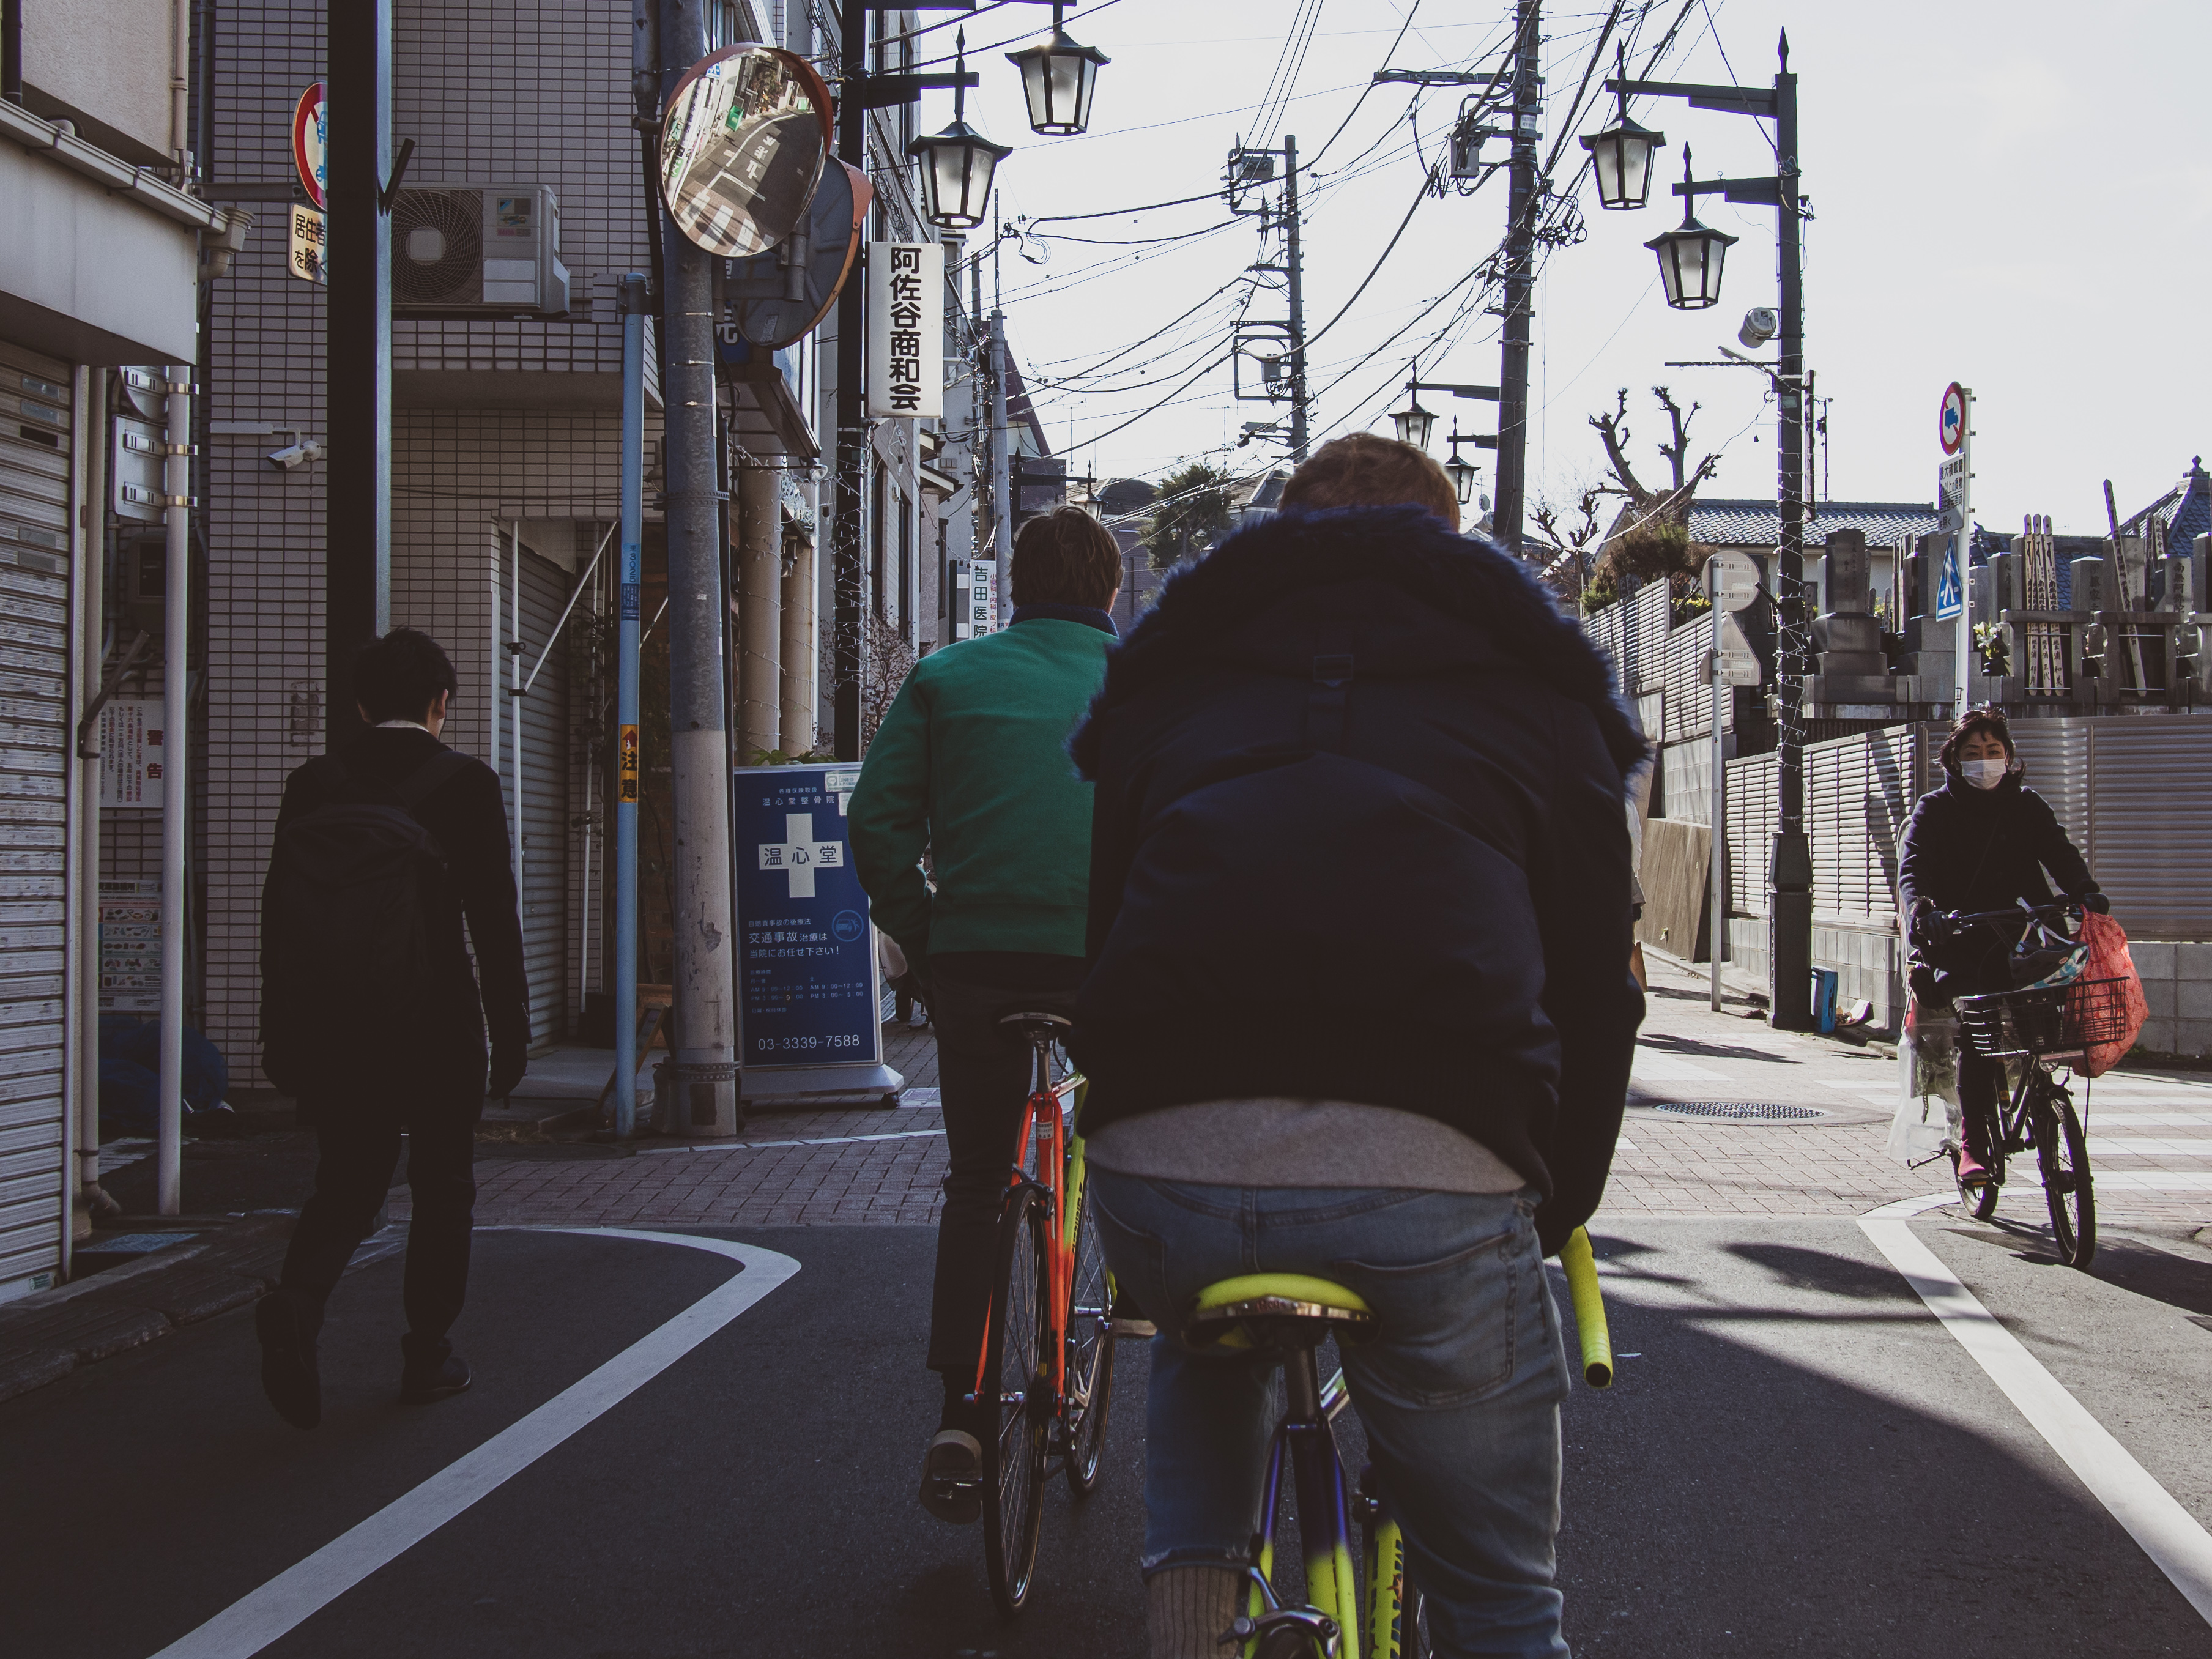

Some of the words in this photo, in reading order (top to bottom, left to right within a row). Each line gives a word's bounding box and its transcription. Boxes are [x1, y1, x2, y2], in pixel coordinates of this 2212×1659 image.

[295, 214, 327, 246] 居住者
[295, 247, 327, 276] を除く
[889, 247, 922, 411] 阿佐谷商和会
[974, 567, 988, 639] 吉田医院
[621, 751, 637, 799] 注意
[762, 795, 835, 806] 温心堂整骨院
[764, 845, 837, 866] 温心堂
[749, 930, 828, 944] 交通事故治療は
[758, 1034, 859, 1050] 03-3339-7588
